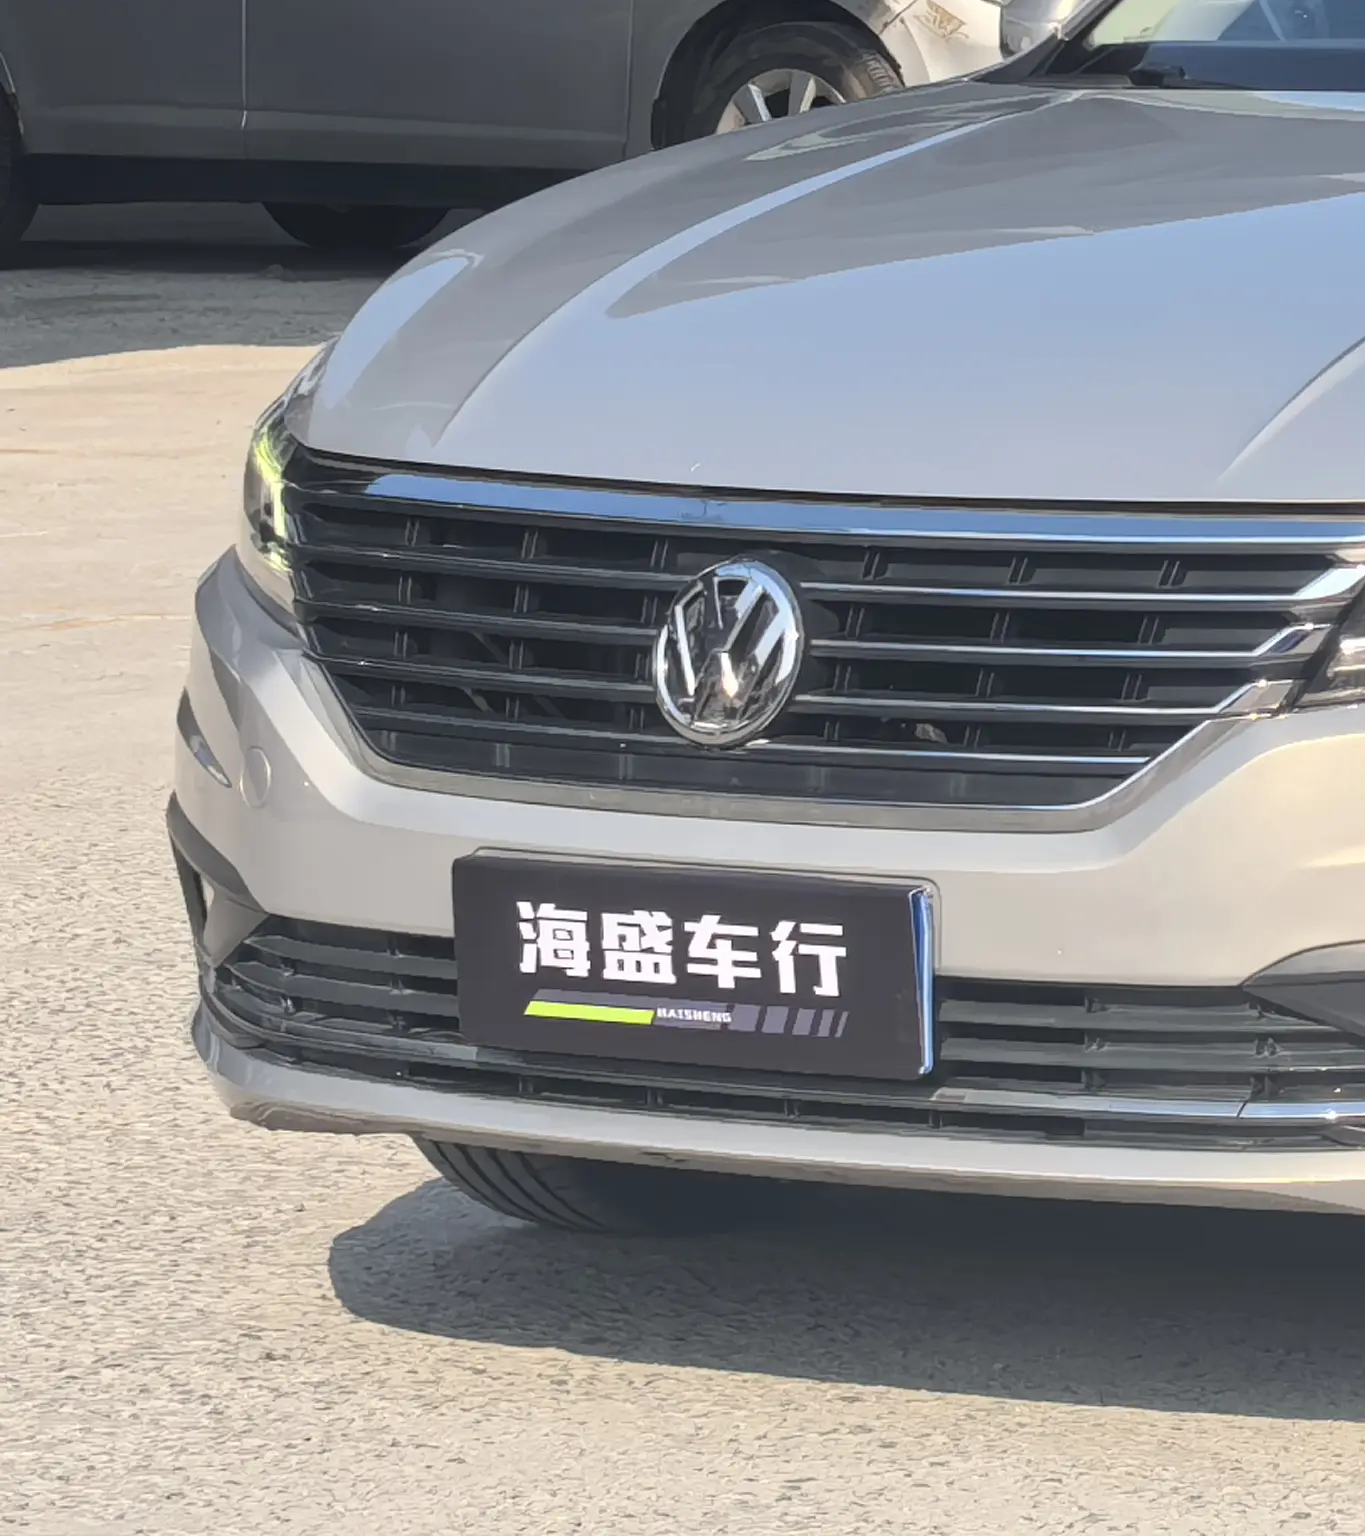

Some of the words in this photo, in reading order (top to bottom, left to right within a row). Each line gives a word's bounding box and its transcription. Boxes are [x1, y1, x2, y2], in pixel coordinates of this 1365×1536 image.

[516, 900, 847, 997] 海盛车行
[656, 1007, 733, 1023] HAISHENG
